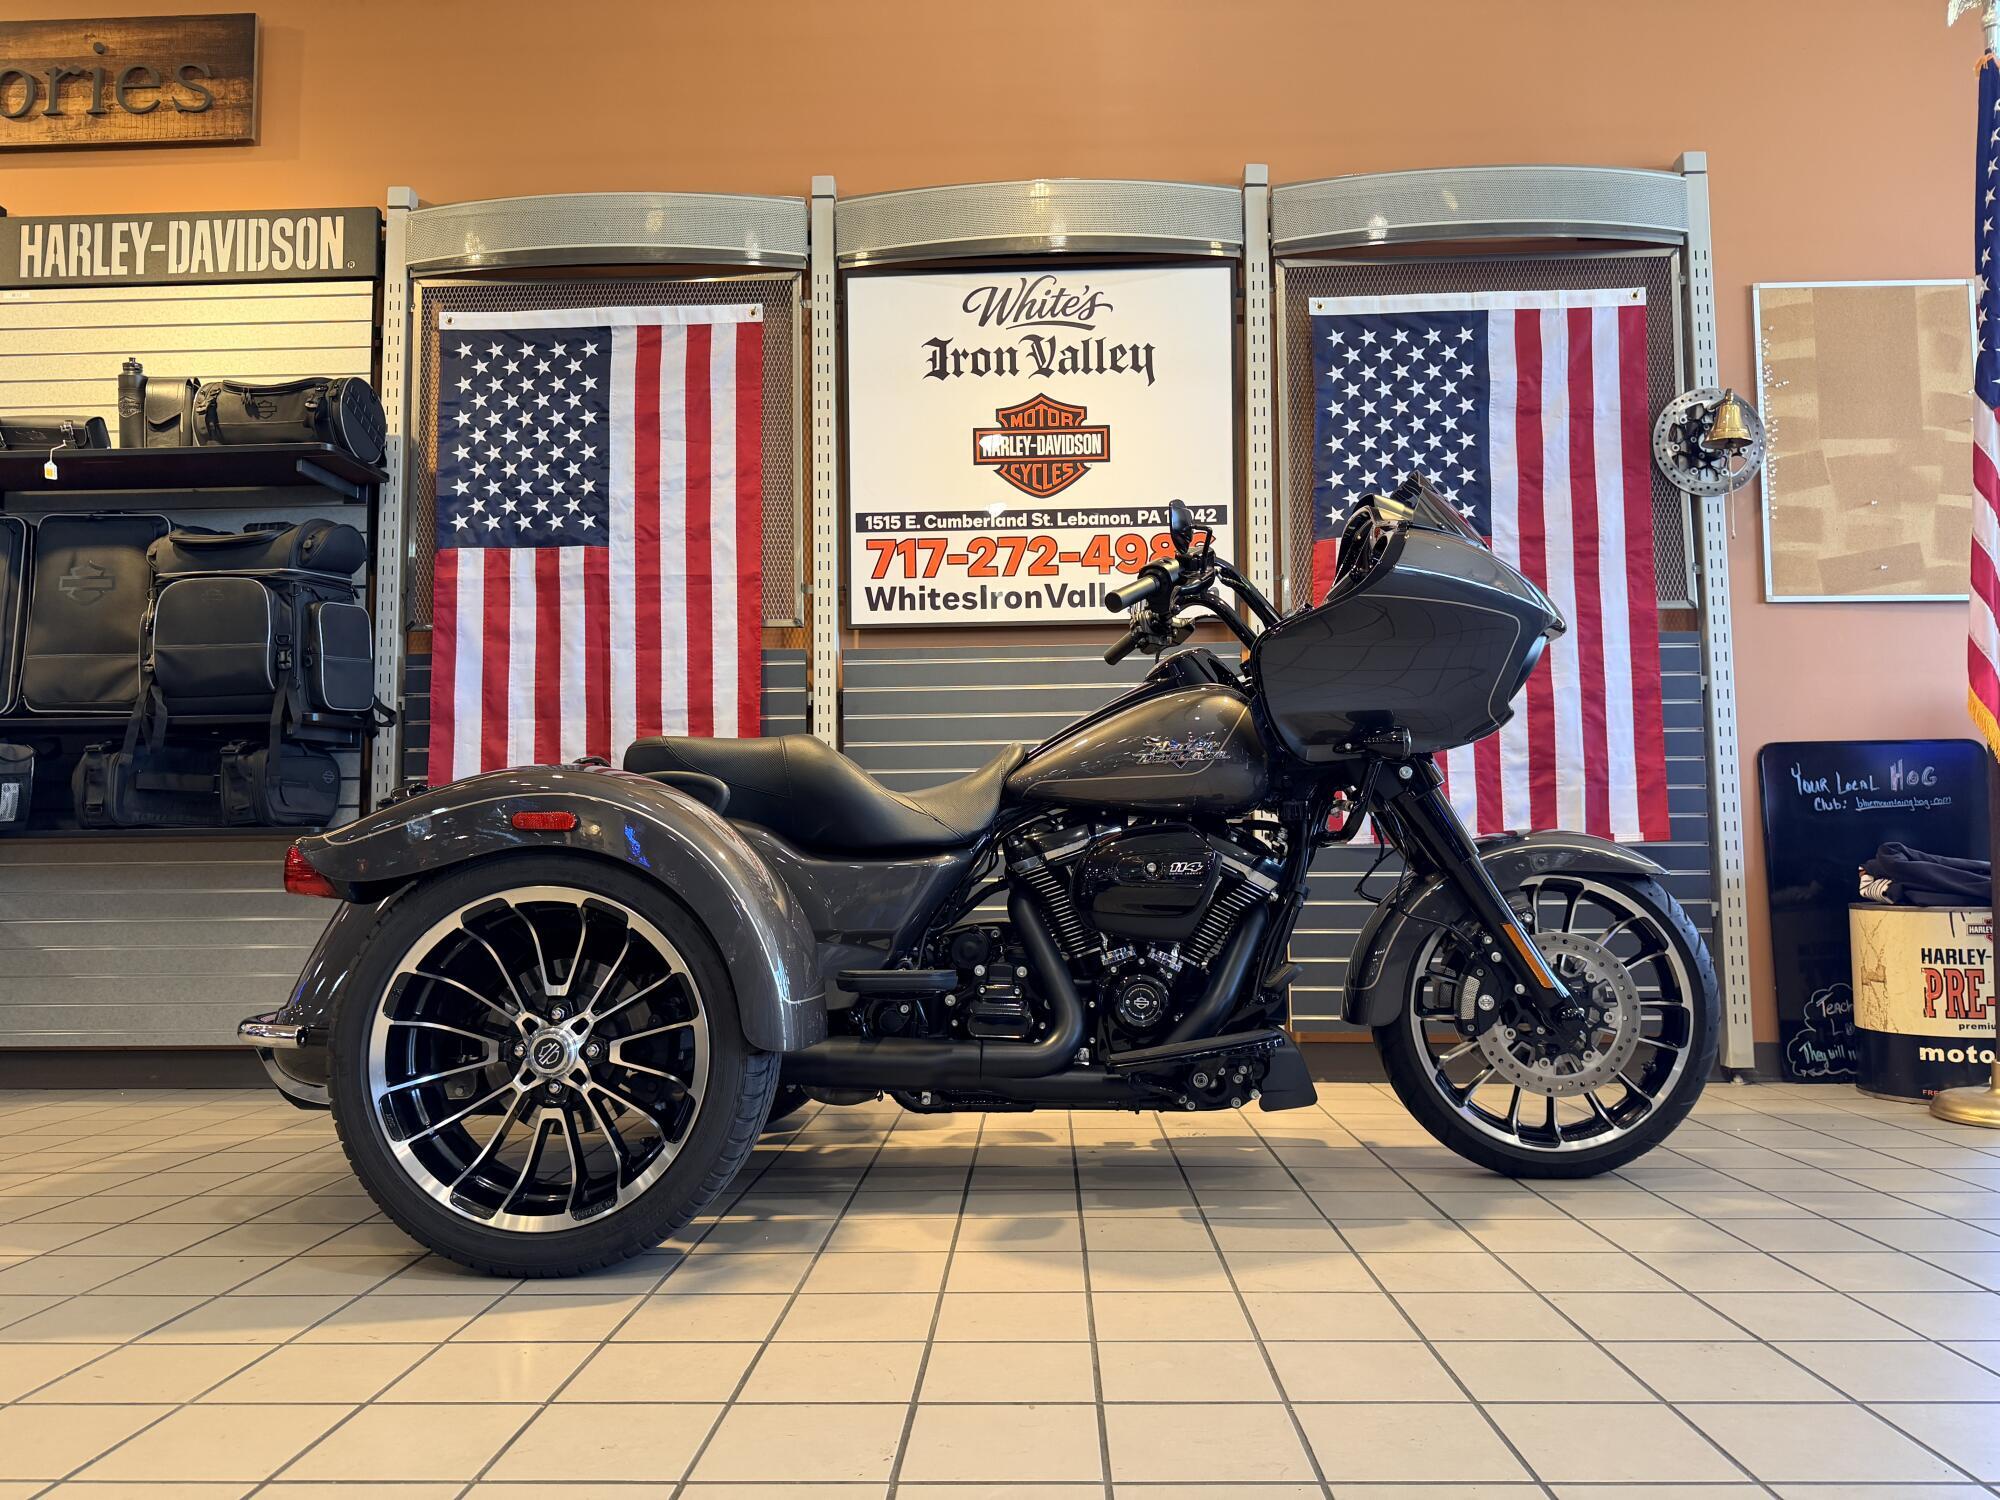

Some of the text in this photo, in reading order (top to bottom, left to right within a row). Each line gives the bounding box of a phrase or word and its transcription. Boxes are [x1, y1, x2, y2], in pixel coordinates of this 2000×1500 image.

[19, 215, 345, 278] HARLEY-DAVIDSON
[962, 274, 1114, 330] White's
[922, 333, 1156, 387] Iron Valley
[1010, 404, 1073, 427] MOTOR
[982, 433, 1102, 457] HARLEY-DAVIDSON
[1010, 463, 1074, 491] CYCLES
[865, 515, 901, 530] 1515
[905, 514, 921, 529] E.
[923, 512, 1028, 529] Cumberland
[1031, 512, 1054, 527] St.
[1056, 510, 1135, 528] Lebanon,
[1137, 511, 1162, 525] PA
[1169, 861, 1204, 873] 114
